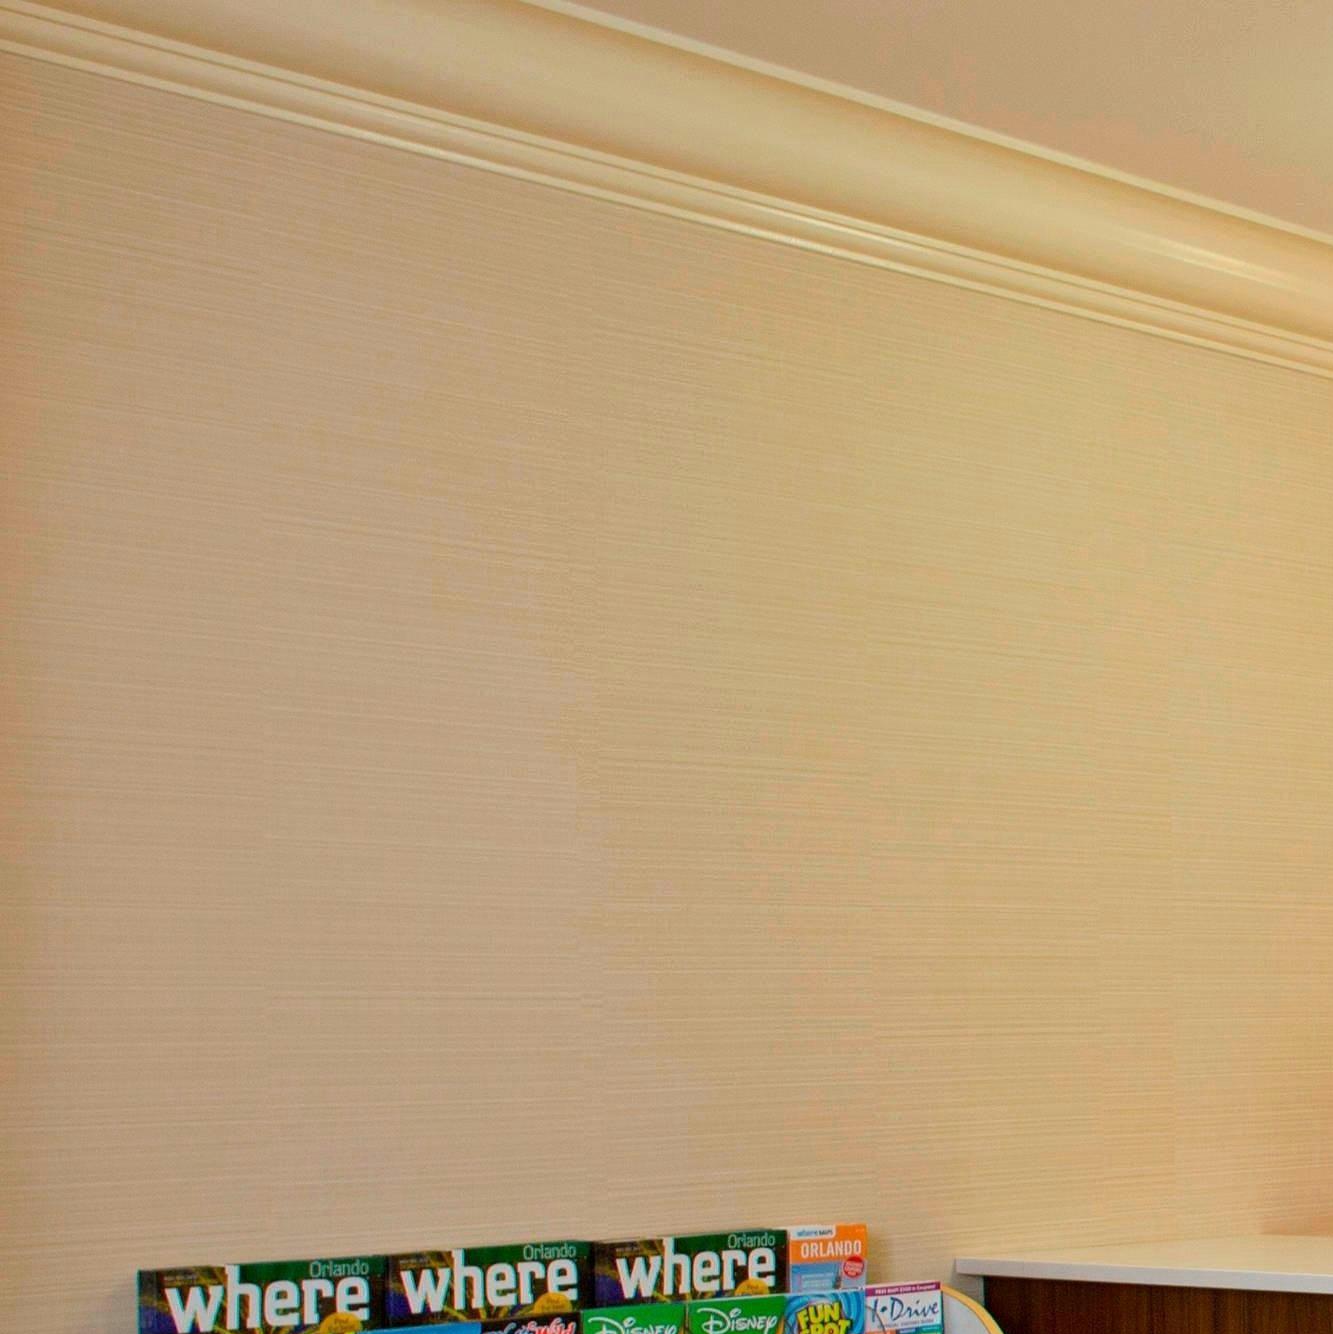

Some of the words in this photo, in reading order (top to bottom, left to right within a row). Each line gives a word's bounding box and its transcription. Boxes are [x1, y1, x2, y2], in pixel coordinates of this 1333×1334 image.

[728, 1232, 776, 1249] Orlando
[801, 1240, 862, 1258] ORLANDO
[523, 1243, 577, 1260] Orlando
[309, 1260, 370, 1277] Orlando
[616, 1236, 776, 1299] where
[400, 1247, 579, 1314] where
[165, 1264, 370, 1334] where
[797, 1303, 840, 1326] FUN
